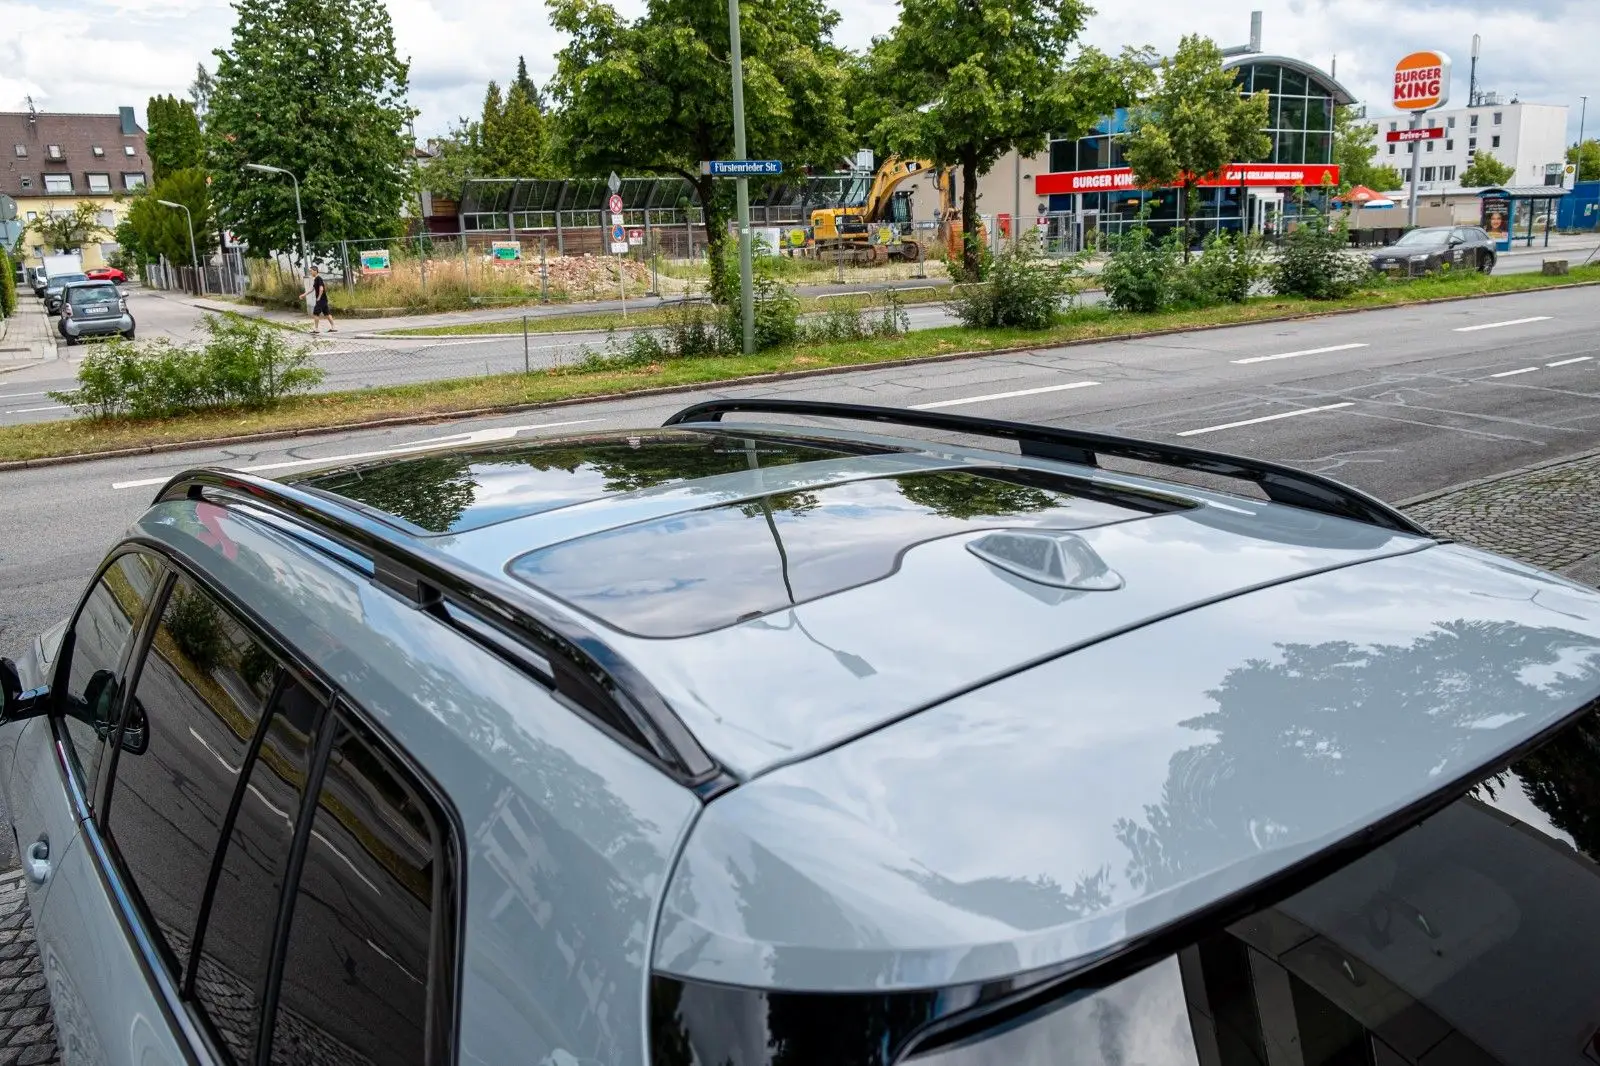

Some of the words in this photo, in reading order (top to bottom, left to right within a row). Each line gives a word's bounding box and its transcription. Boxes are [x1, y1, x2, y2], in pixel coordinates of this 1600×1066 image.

[1395, 67, 1441, 84] BURGER
[1394, 80, 1440, 100] KING
[1399, 130, 1430, 141] Drive-in
[714, 162, 764, 173] Fürstenrieder
[765, 162, 778, 172] Str.
[1072, 174, 1112, 189] BURGER
